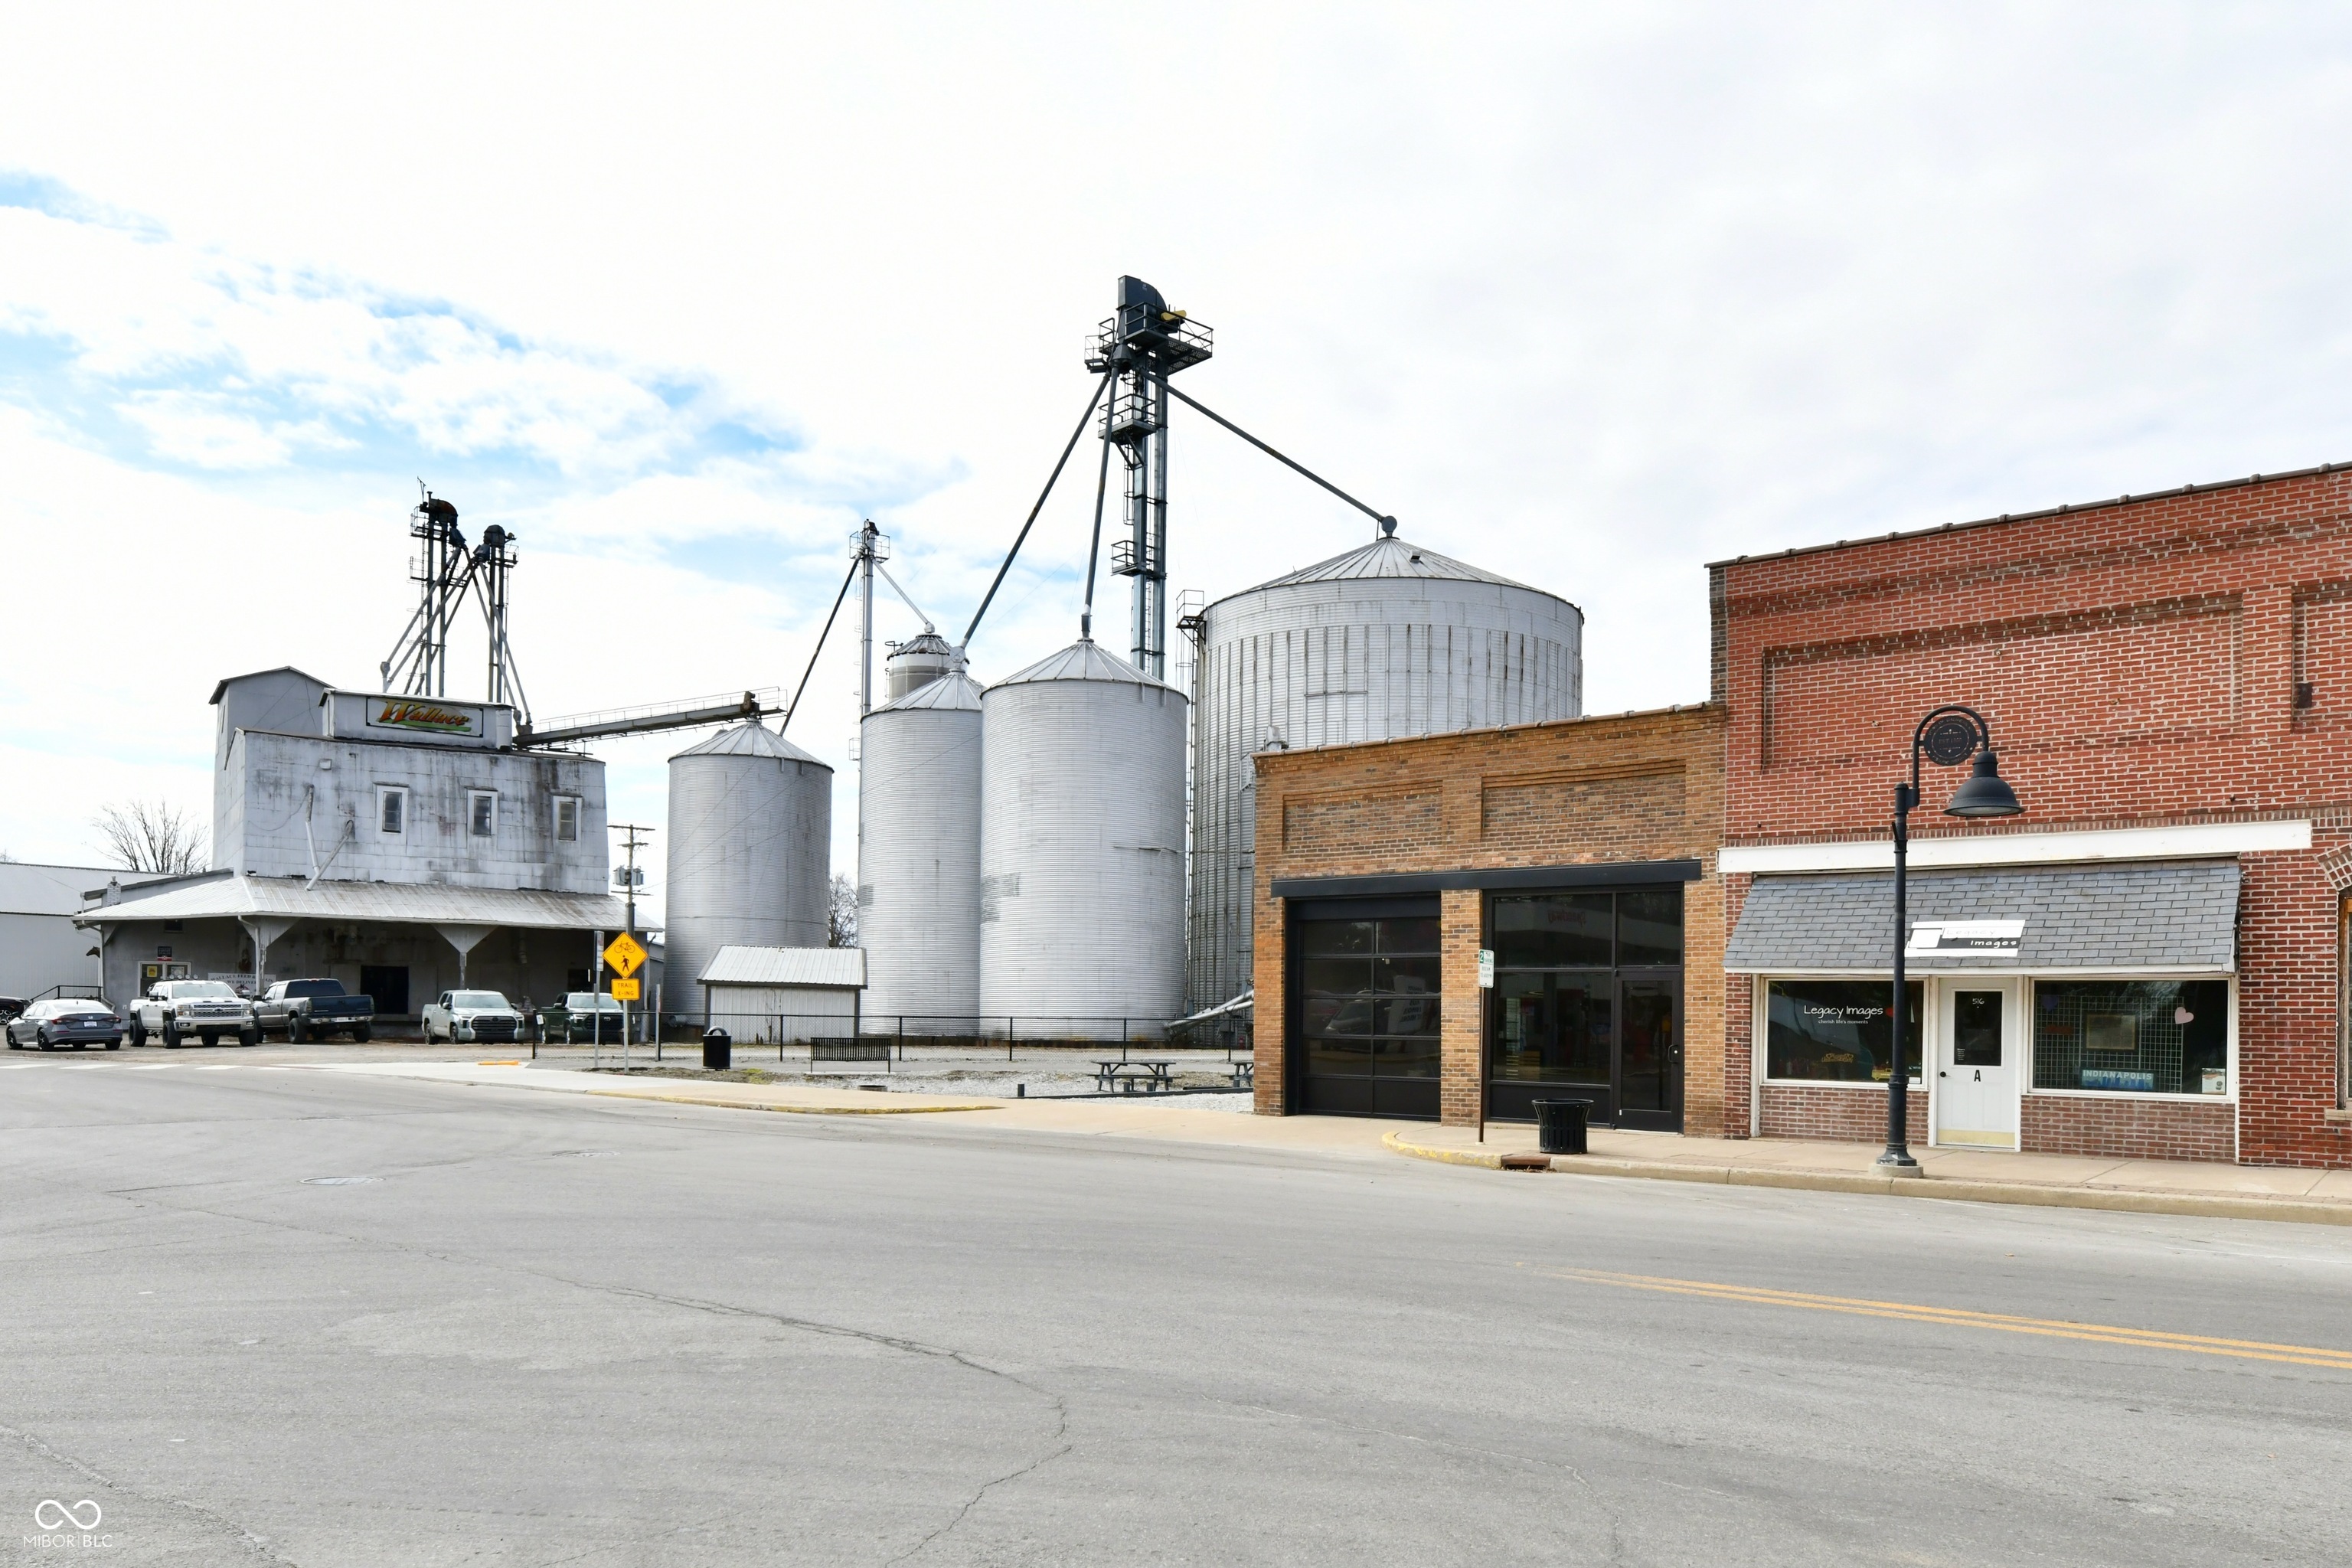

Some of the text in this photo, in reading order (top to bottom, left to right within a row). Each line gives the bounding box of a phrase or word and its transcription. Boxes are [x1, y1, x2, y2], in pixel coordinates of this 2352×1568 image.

[379, 701, 470, 727] Wallace
[1971, 939, 2017, 949] Images
[1480, 952, 1485, 962] 2
[1804, 1004, 1883, 1020] Legacy Images
[1974, 1070, 1981, 1082] A
[2082, 1070, 2152, 1080] INDIANAPOLIS
